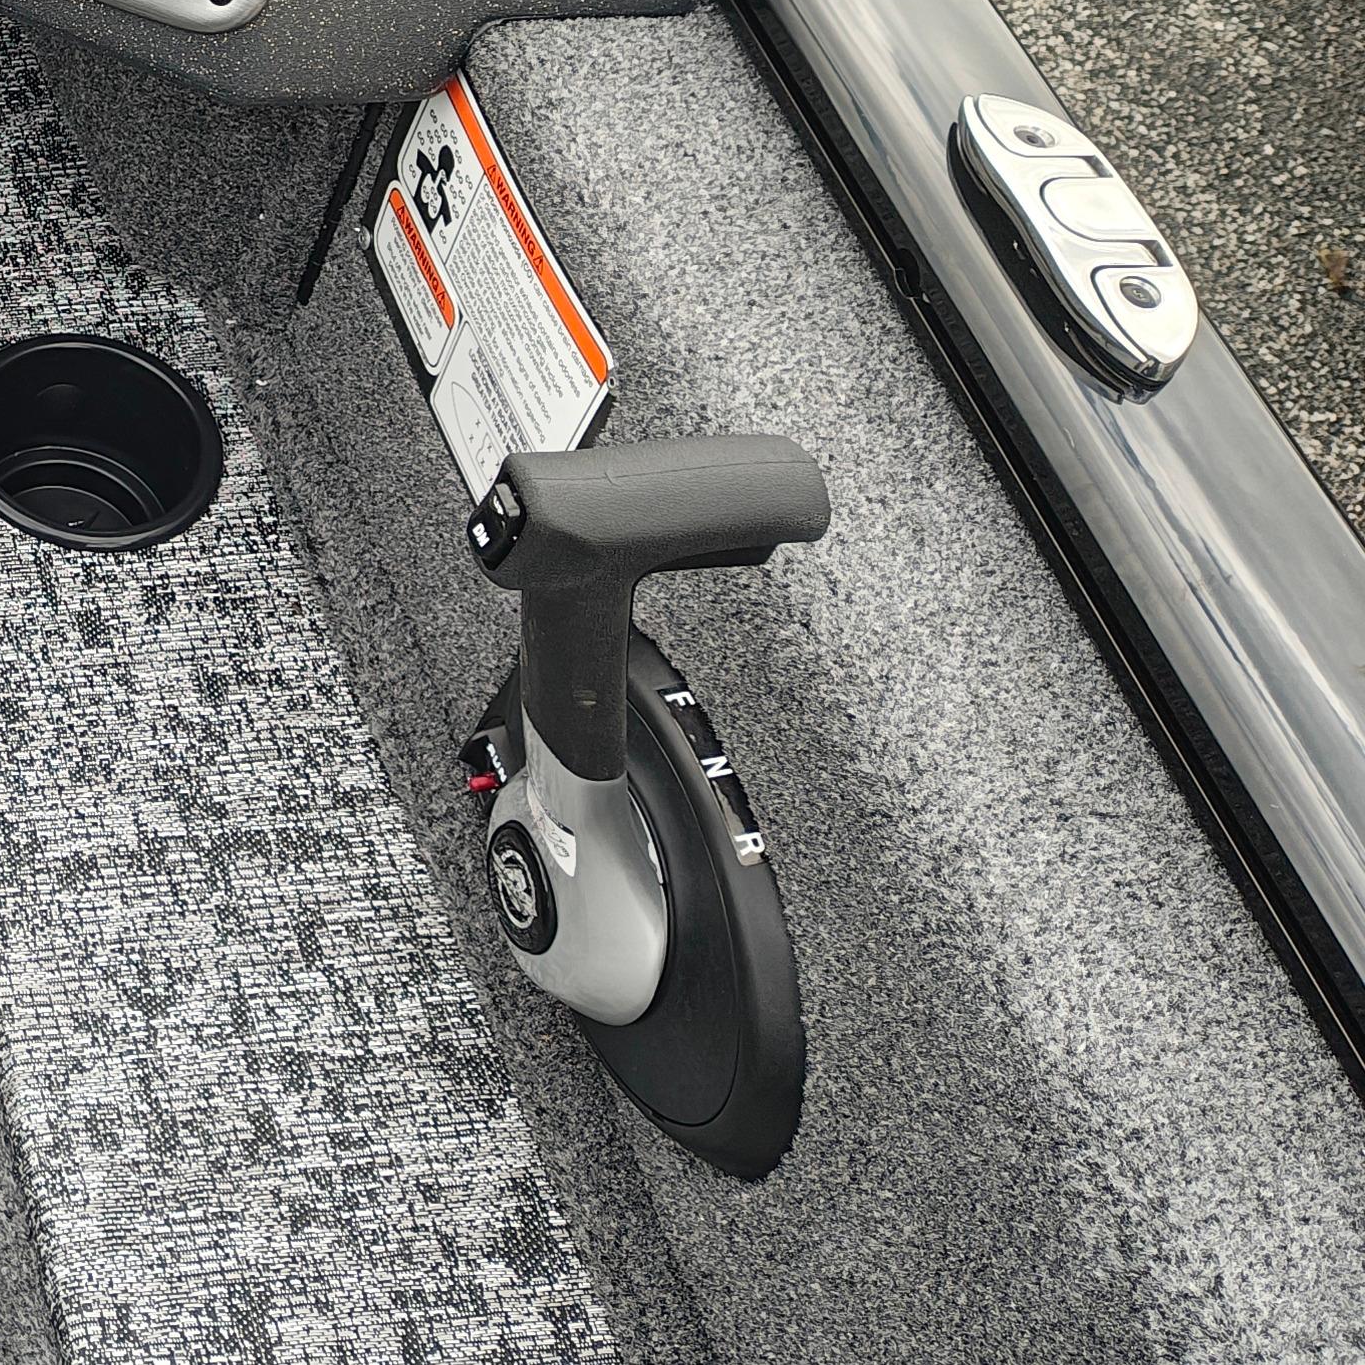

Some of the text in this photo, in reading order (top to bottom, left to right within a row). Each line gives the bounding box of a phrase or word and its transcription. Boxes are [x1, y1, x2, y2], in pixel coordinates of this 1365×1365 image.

[494, 176, 537, 256] WARNING
[401, 216, 441, 292] WARNING
[520, 258, 533, 283] (CO)
[558, 325, 571, 351] brain
[571, 348, 592, 390] damage
[470, 371, 491, 412] GREATER
[490, 411, 503, 437] THAN
[497, 408, 510, 433] BOAT
[664, 691, 696, 706] F
[486, 742, 508, 784] RUN
[700, 756, 734, 779] N
[734, 832, 766, 857] R
